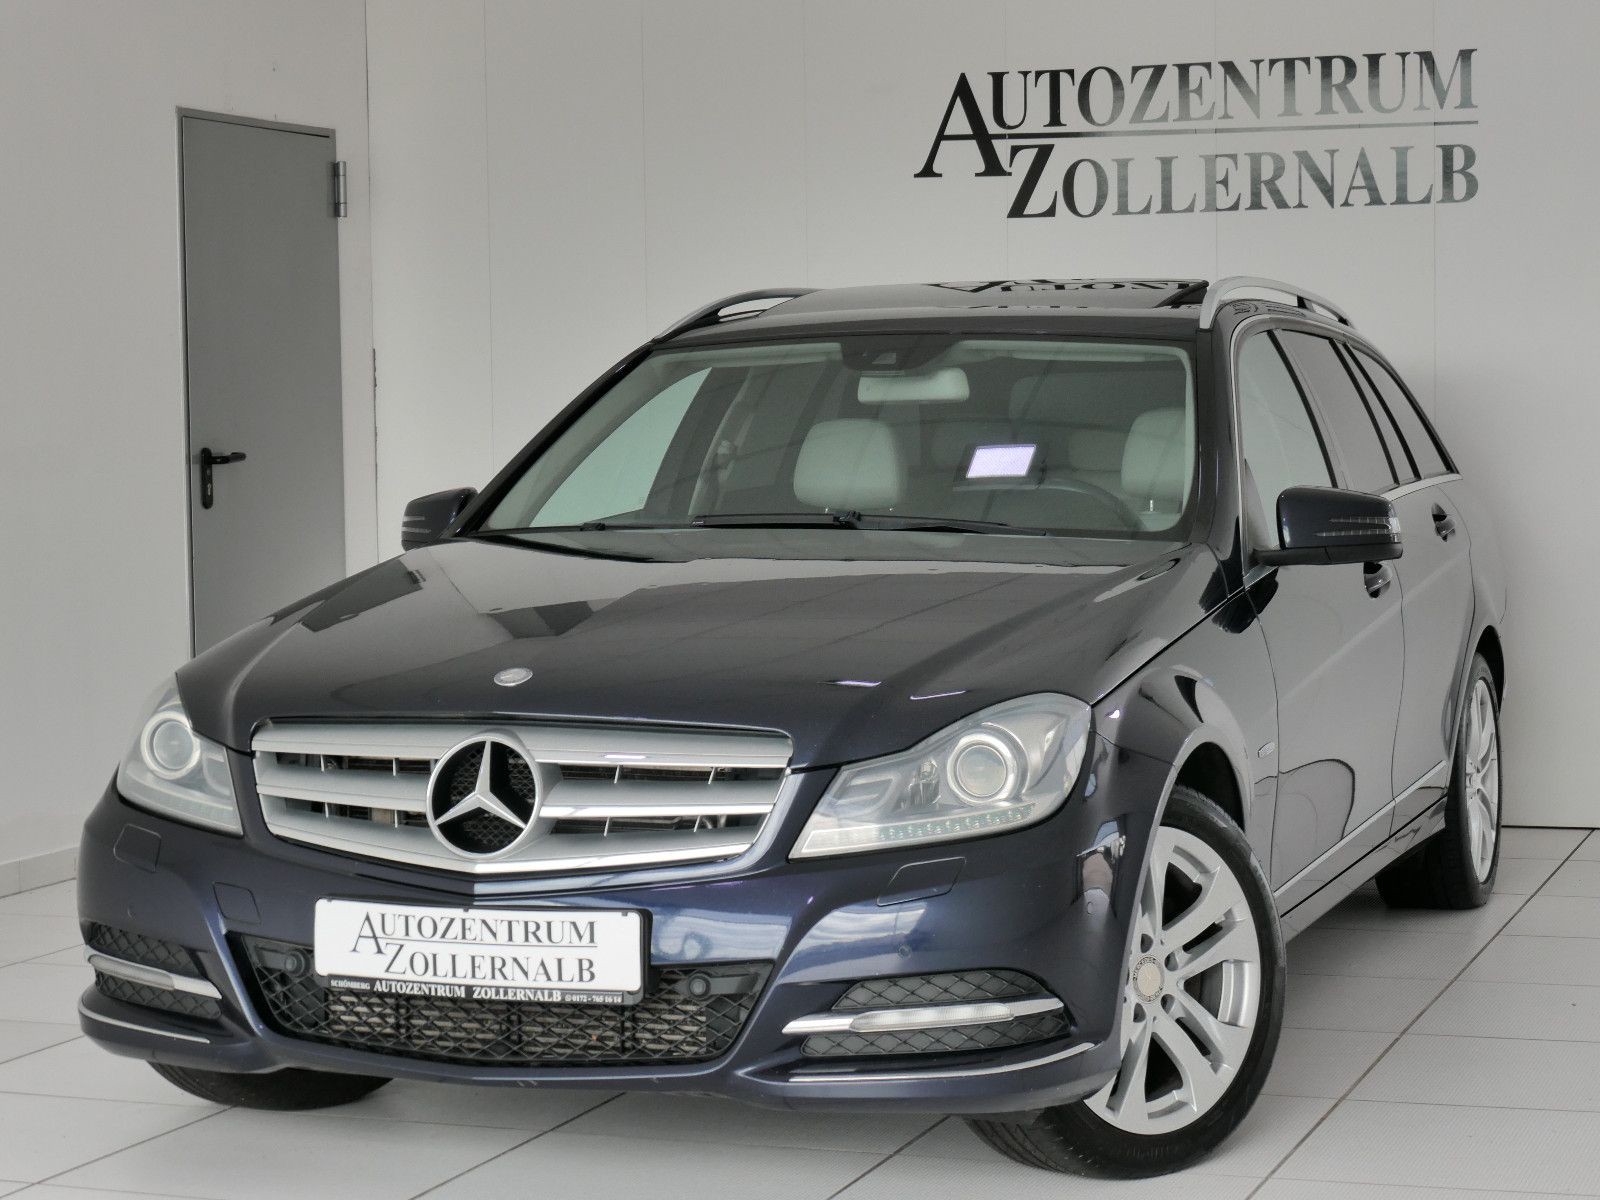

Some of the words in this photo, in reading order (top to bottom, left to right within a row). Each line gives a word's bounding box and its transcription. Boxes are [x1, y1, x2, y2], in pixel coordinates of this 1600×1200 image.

[913, 48, 1479, 178] AUTOZENTRUM
[1007, 143, 1479, 219] ZOLLERNALB
[351, 911, 598, 955] AUTOZENTRUM
[384, 942, 597, 984] ZOLLERNALB
[373, 980, 466, 998] AUTOZENTRUM
[472, 986, 562, 1002] ZOLLERNALB
